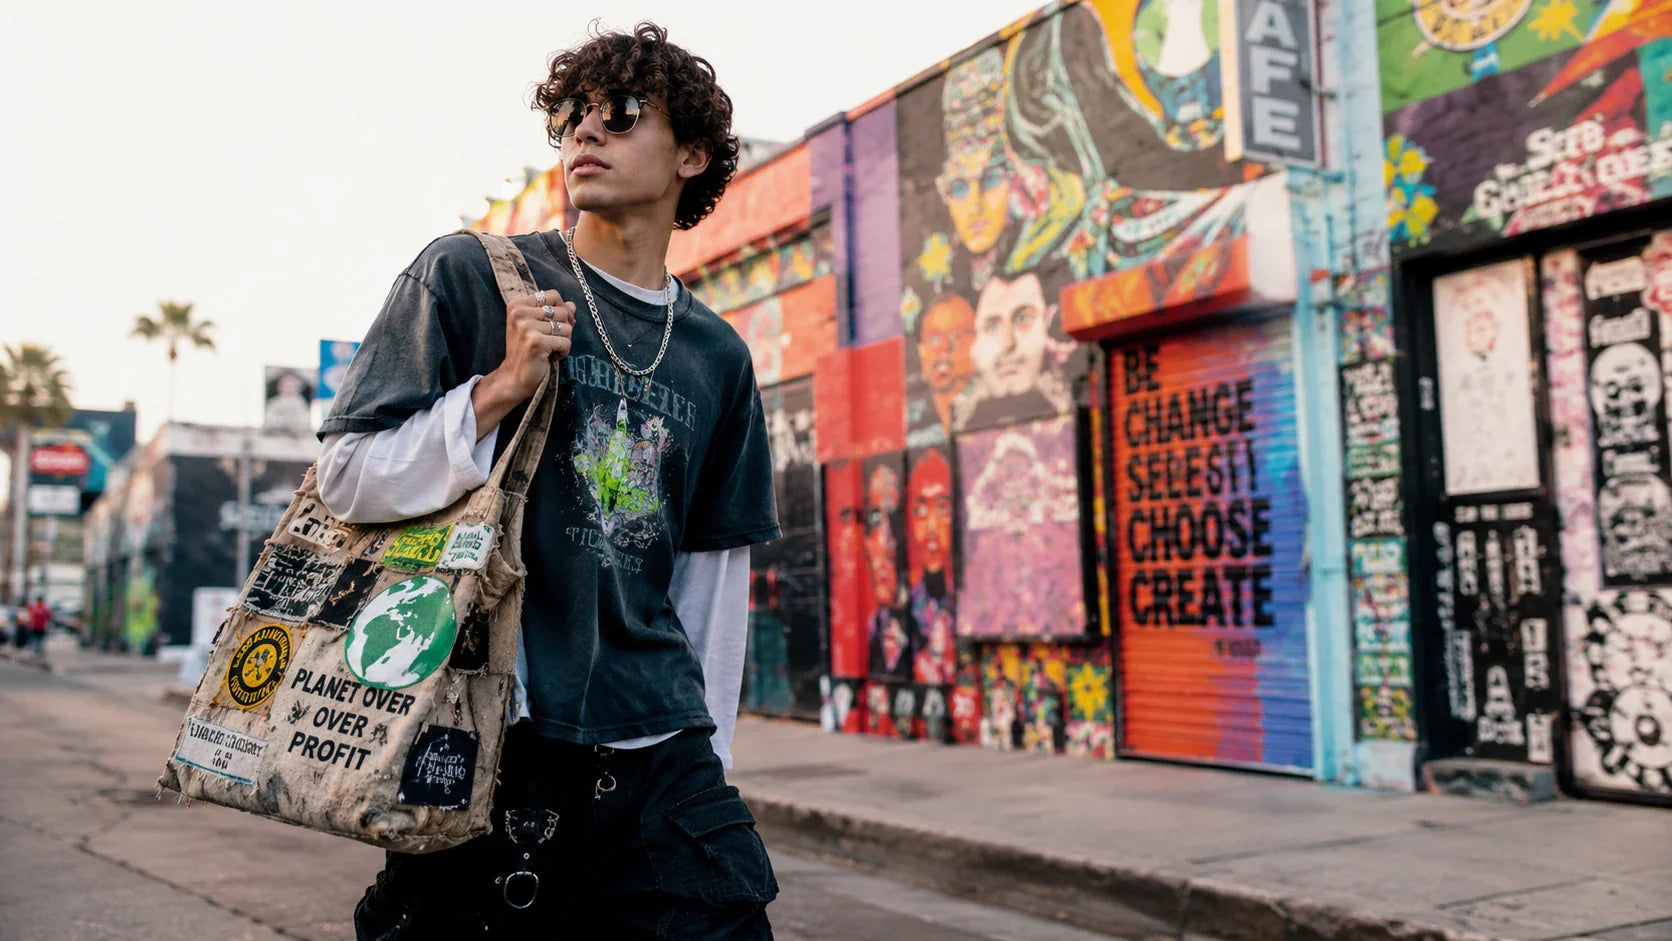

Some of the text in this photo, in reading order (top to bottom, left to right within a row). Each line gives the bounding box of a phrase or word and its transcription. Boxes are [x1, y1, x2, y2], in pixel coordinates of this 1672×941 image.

[1124, 346, 1160, 394] BE
[1125, 380, 1254, 447] CHANGE
[1128, 497, 1272, 562] CHOOSE
[1130, 564, 1274, 626] CREATE
[291, 668, 416, 716] PLANET OVER
[313, 707, 368, 738] OVER
[287, 731, 371, 770] PROFIT
